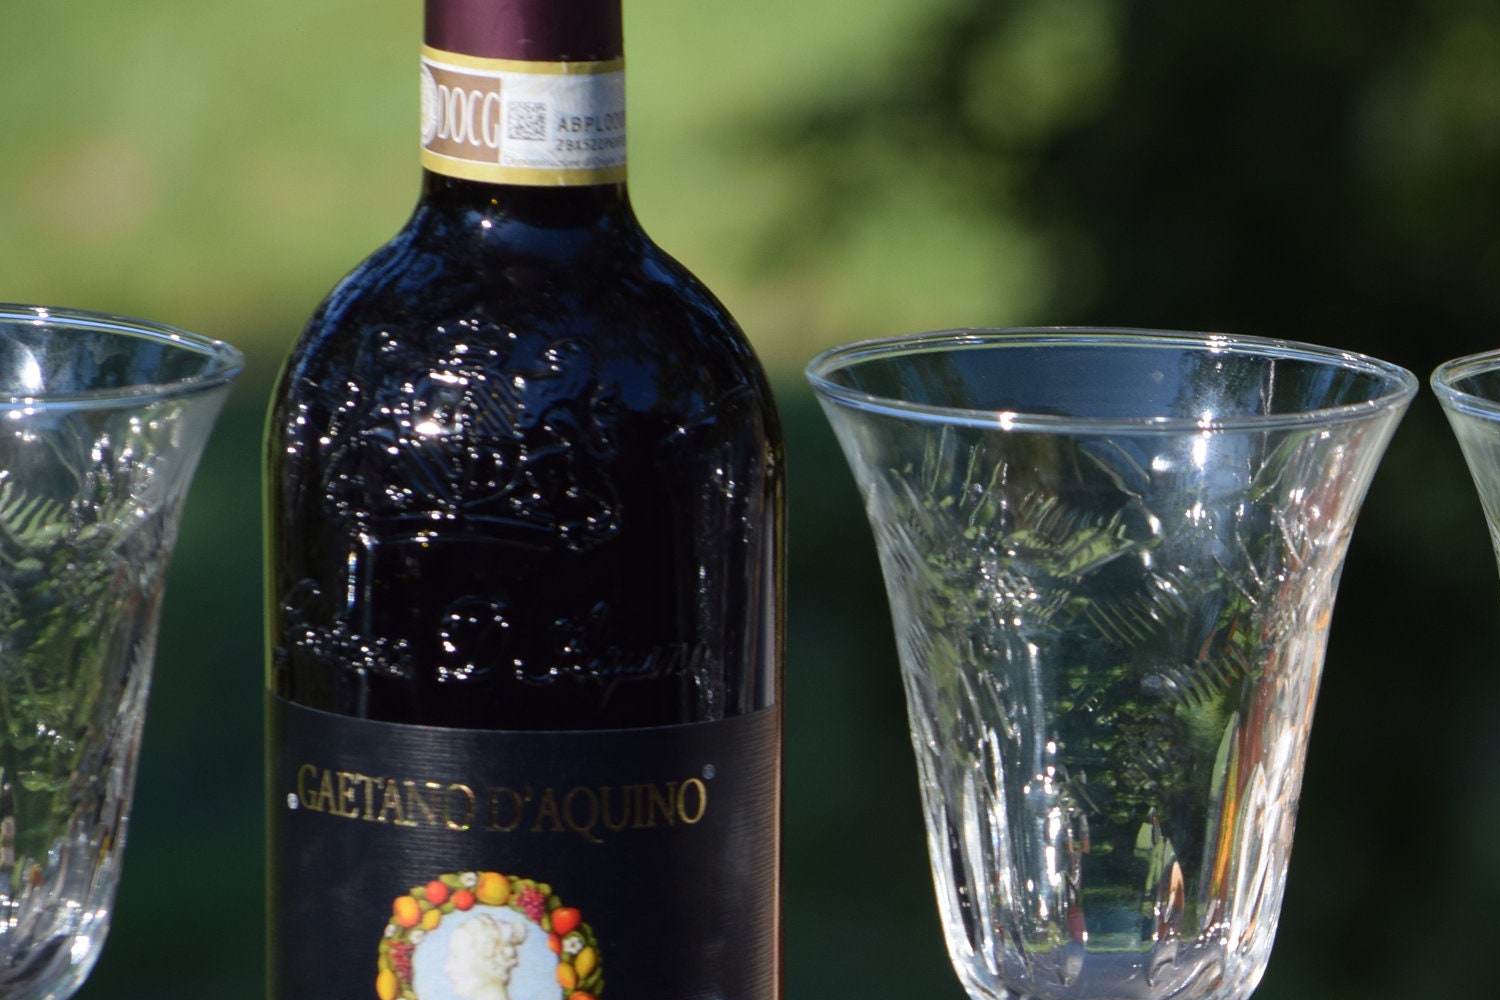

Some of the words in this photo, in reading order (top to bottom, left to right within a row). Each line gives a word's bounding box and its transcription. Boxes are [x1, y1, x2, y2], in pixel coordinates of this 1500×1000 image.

[437, 84, 500, 148] DOCG
[297, 763, 476, 831] GAETANO
[487, 777, 707, 843] D'AQUINO
